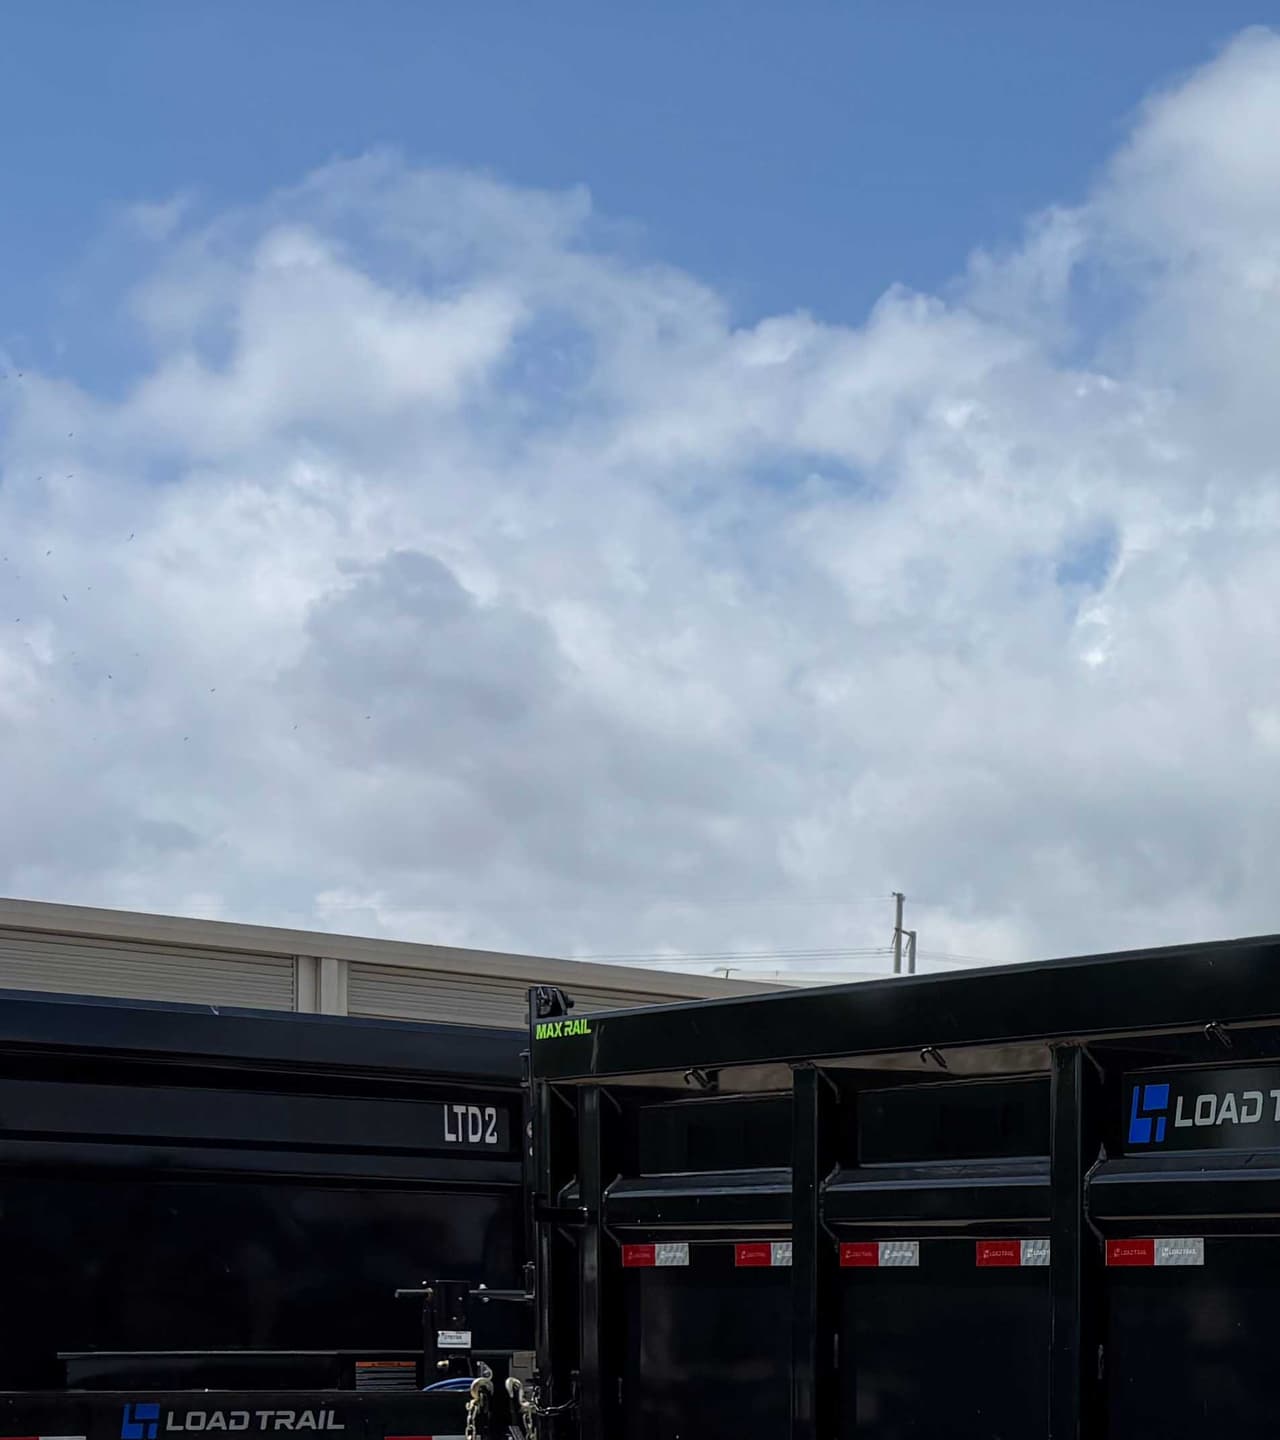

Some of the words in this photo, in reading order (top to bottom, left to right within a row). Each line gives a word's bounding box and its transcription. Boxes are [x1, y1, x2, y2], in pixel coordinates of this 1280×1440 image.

[536, 1022, 562, 1040] MAX
[564, 1018, 592, 1036] RAIL
[443, 1104, 498, 1144] LTD2
[1174, 1091, 1263, 1128] LOAD
[165, 1410, 252, 1431] LOAD
[256, 1410, 345, 1430] TRAIL
